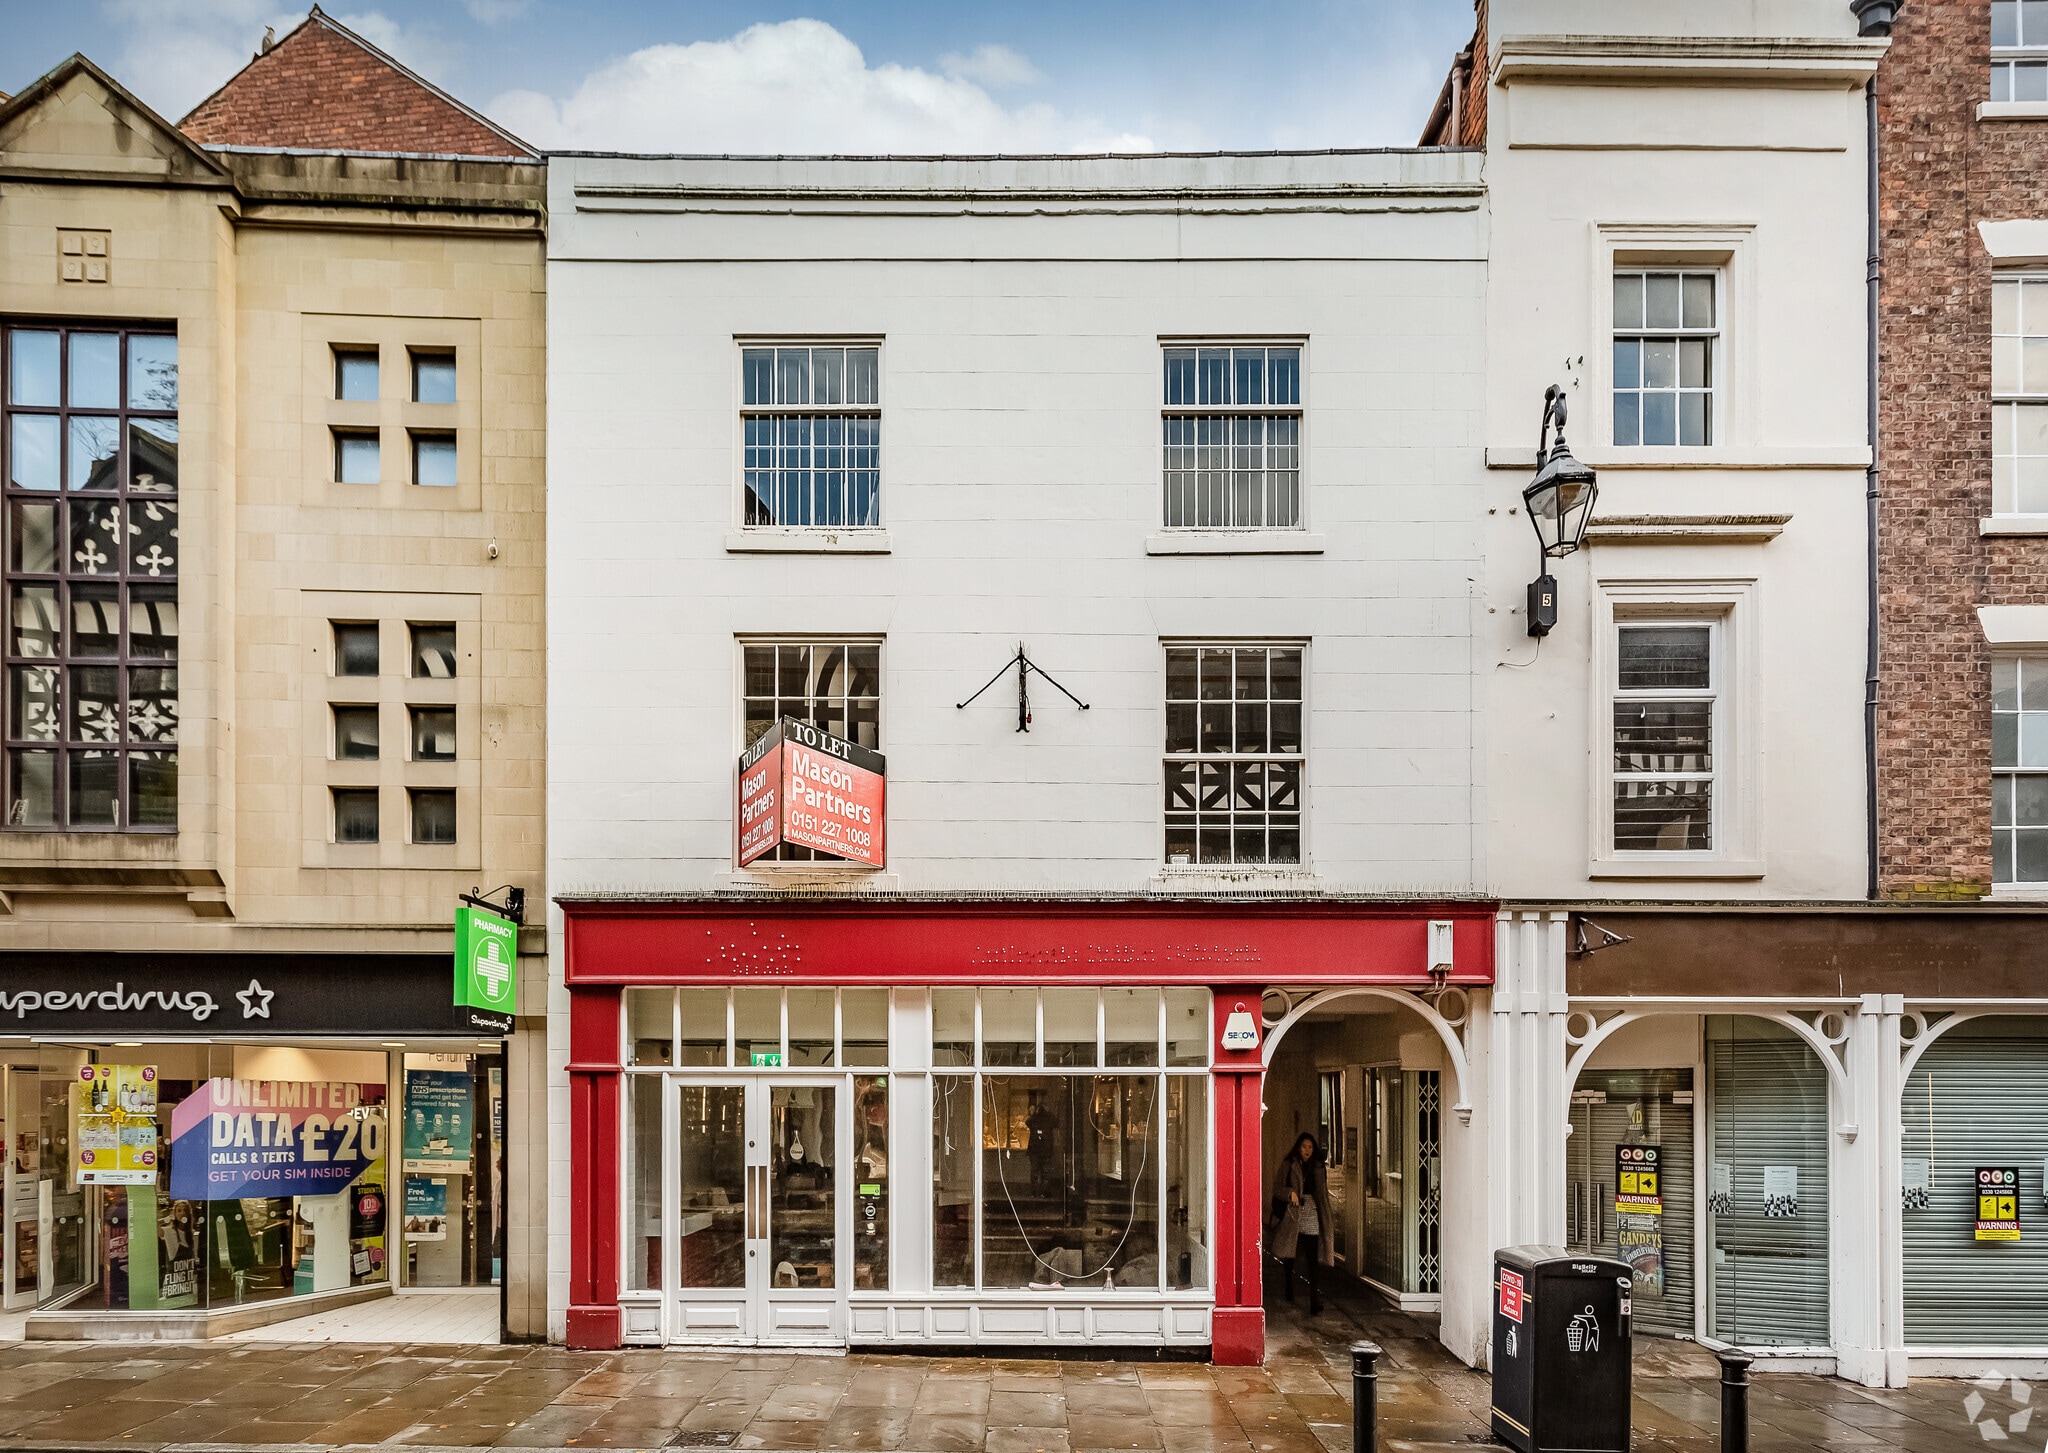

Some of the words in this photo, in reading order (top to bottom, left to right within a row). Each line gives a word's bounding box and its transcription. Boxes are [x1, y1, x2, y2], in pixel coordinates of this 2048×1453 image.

[1543, 595, 1551, 605] 5
[741, 752, 752, 771] TO
[752, 737, 767, 763] LET
[792, 721, 817, 747] TO
[820, 733, 852, 760] LET
[741, 769, 767, 803] Mason
[792, 748, 853, 793] Mason
[741, 788, 775, 828] Partners
[791, 776, 871, 825] Partners
[762, 815, 775, 836] 1008
[791, 809, 818, 832] 0151
[821, 819, 842, 838] 227
[845, 827, 871, 847] 1008
[791, 828, 871, 859] MASONPARTNERS.COM
[474, 918, 513, 938] PHARMACY
[0, 982, 219, 1021] uperdrug
[471, 1014, 509, 1031] Superdrug
[212, 1077, 360, 1109] UNLIMITED
[212, 1112, 294, 1148] DATA
[300, 1113, 385, 1162] £20
[211, 1151, 247, 1165] CALLS
[250, 1152, 259, 1164] &
[262, 1151, 295, 1164] TEXTS
[209, 1170, 237, 1182] GET
[243, 1169, 280, 1181] YOUR
[284, 1168, 307, 1179] SIM
[310, 1167, 351, 1179] INSIDE
[1618, 1195, 1659, 1204] WARNING
[1978, 1221, 2017, 1230] WARNING
[1506, 1287, 1516, 1299] Keep
